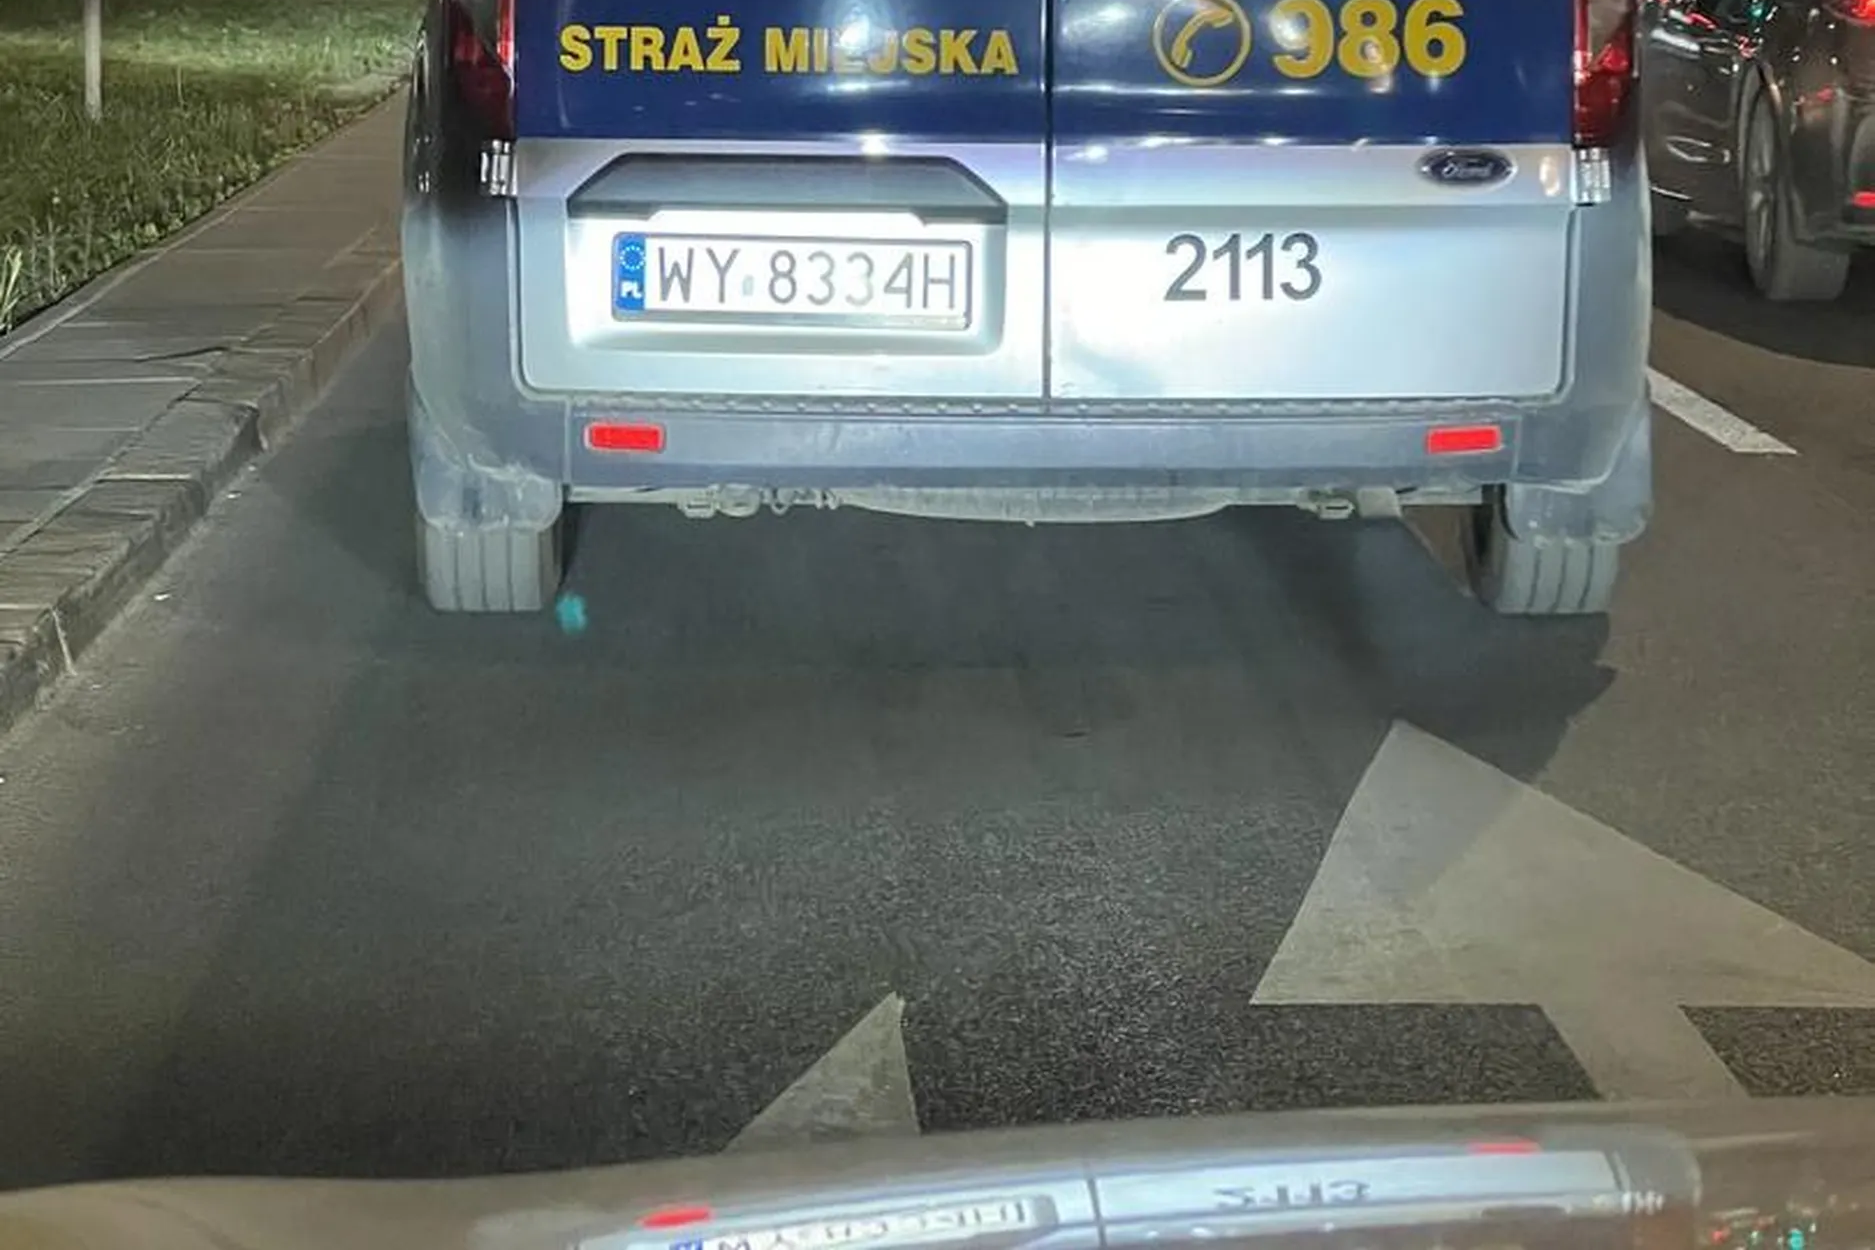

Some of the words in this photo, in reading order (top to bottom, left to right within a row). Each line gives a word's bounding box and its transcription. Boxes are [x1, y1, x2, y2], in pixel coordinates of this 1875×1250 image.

[559, 16, 741, 72] STRAŻ
[620, 280, 642, 298] PL
[658, 246, 741, 303] WY
[769, 249, 956, 309] 8334H
[1164, 232, 1322, 301] 2113
